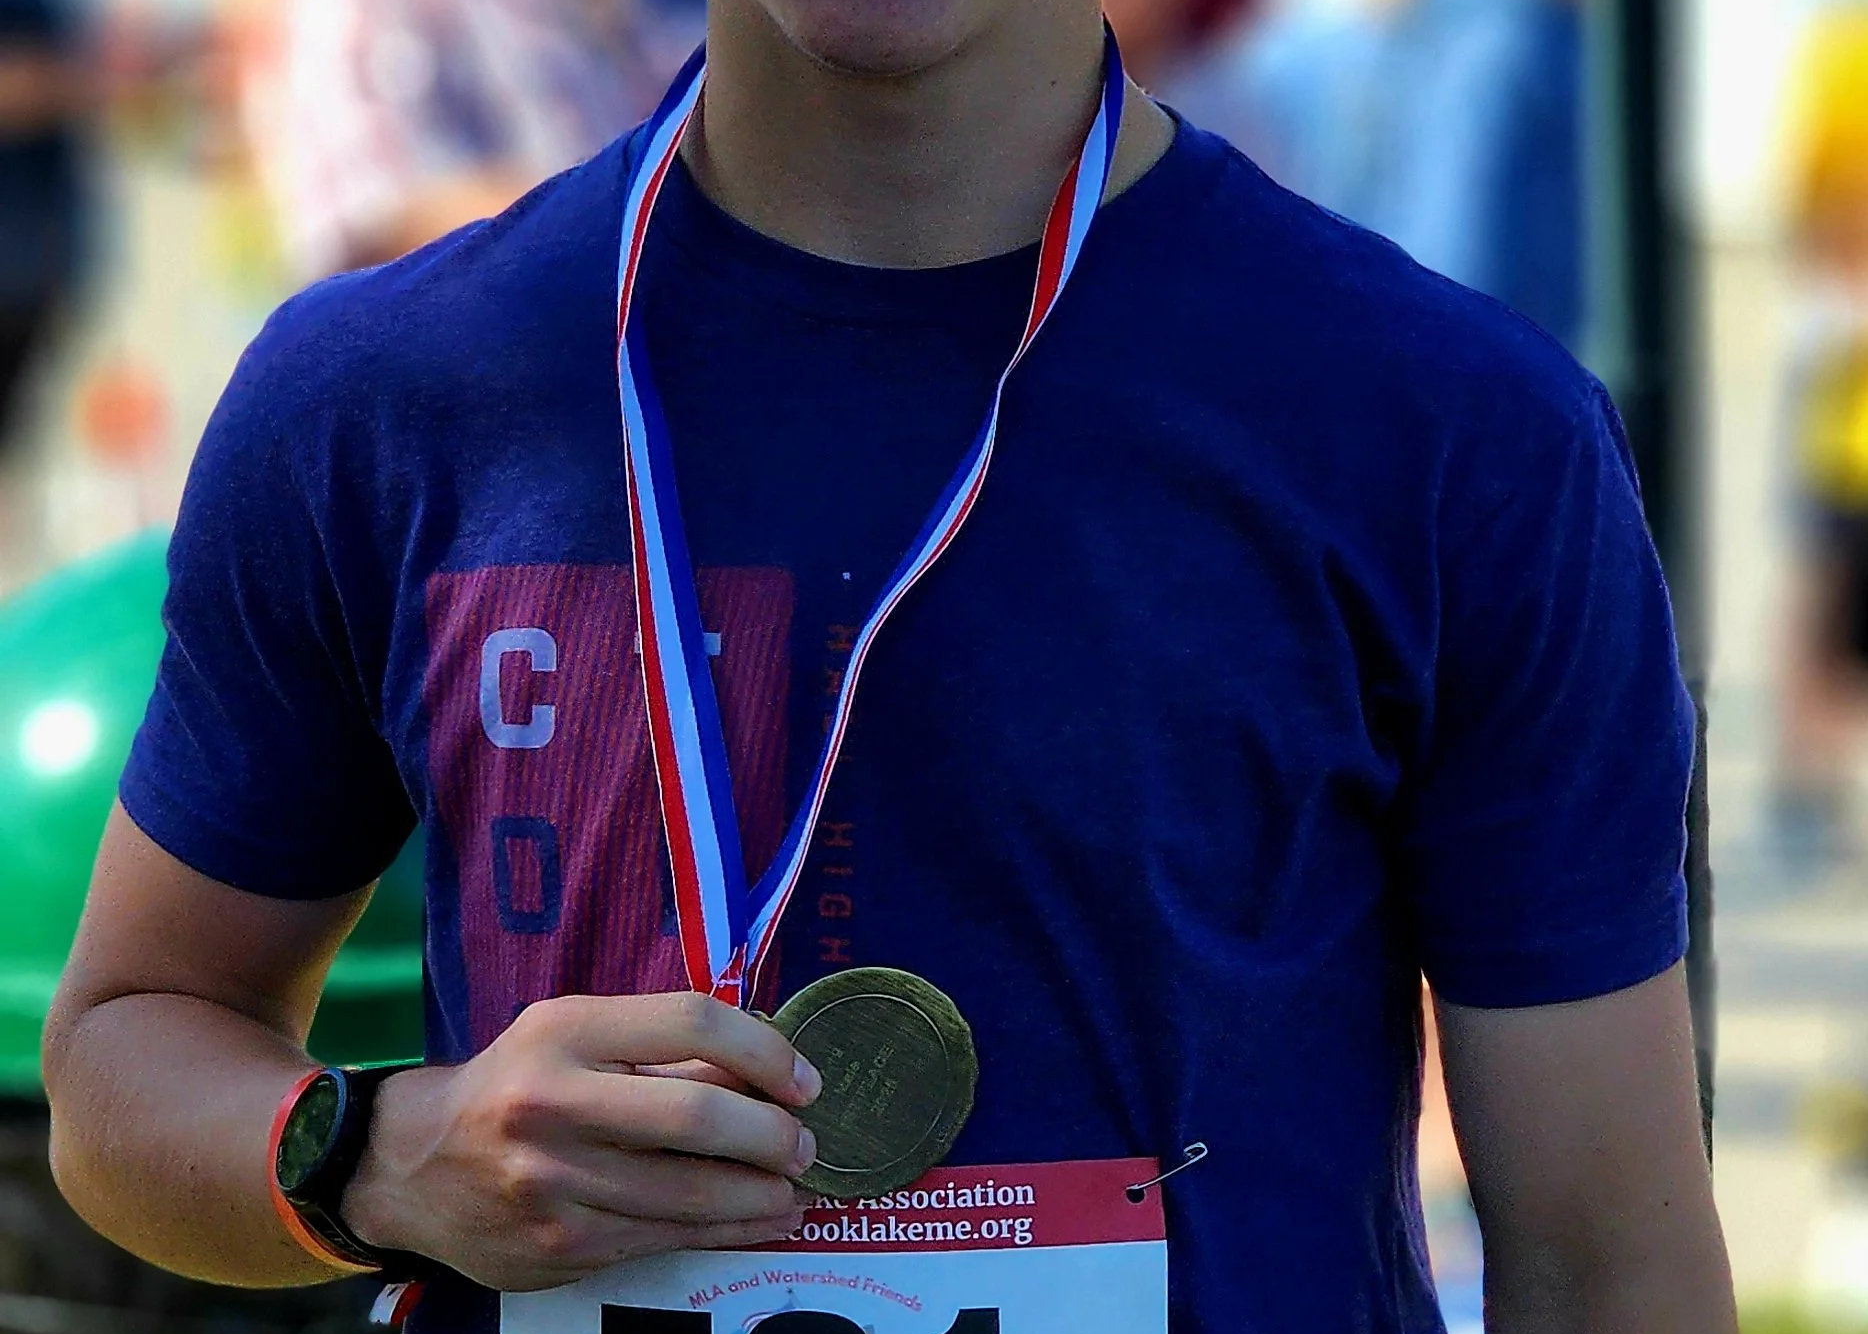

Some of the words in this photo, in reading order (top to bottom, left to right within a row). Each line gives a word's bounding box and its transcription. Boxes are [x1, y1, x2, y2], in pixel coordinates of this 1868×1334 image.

[480, 628, 557, 749] C
[688, 1284, 725, 1310] MLA
[728, 1273, 760, 1293] and
[763, 1269, 860, 1289] Watershed
[862, 1277, 923, 1312] Friends
